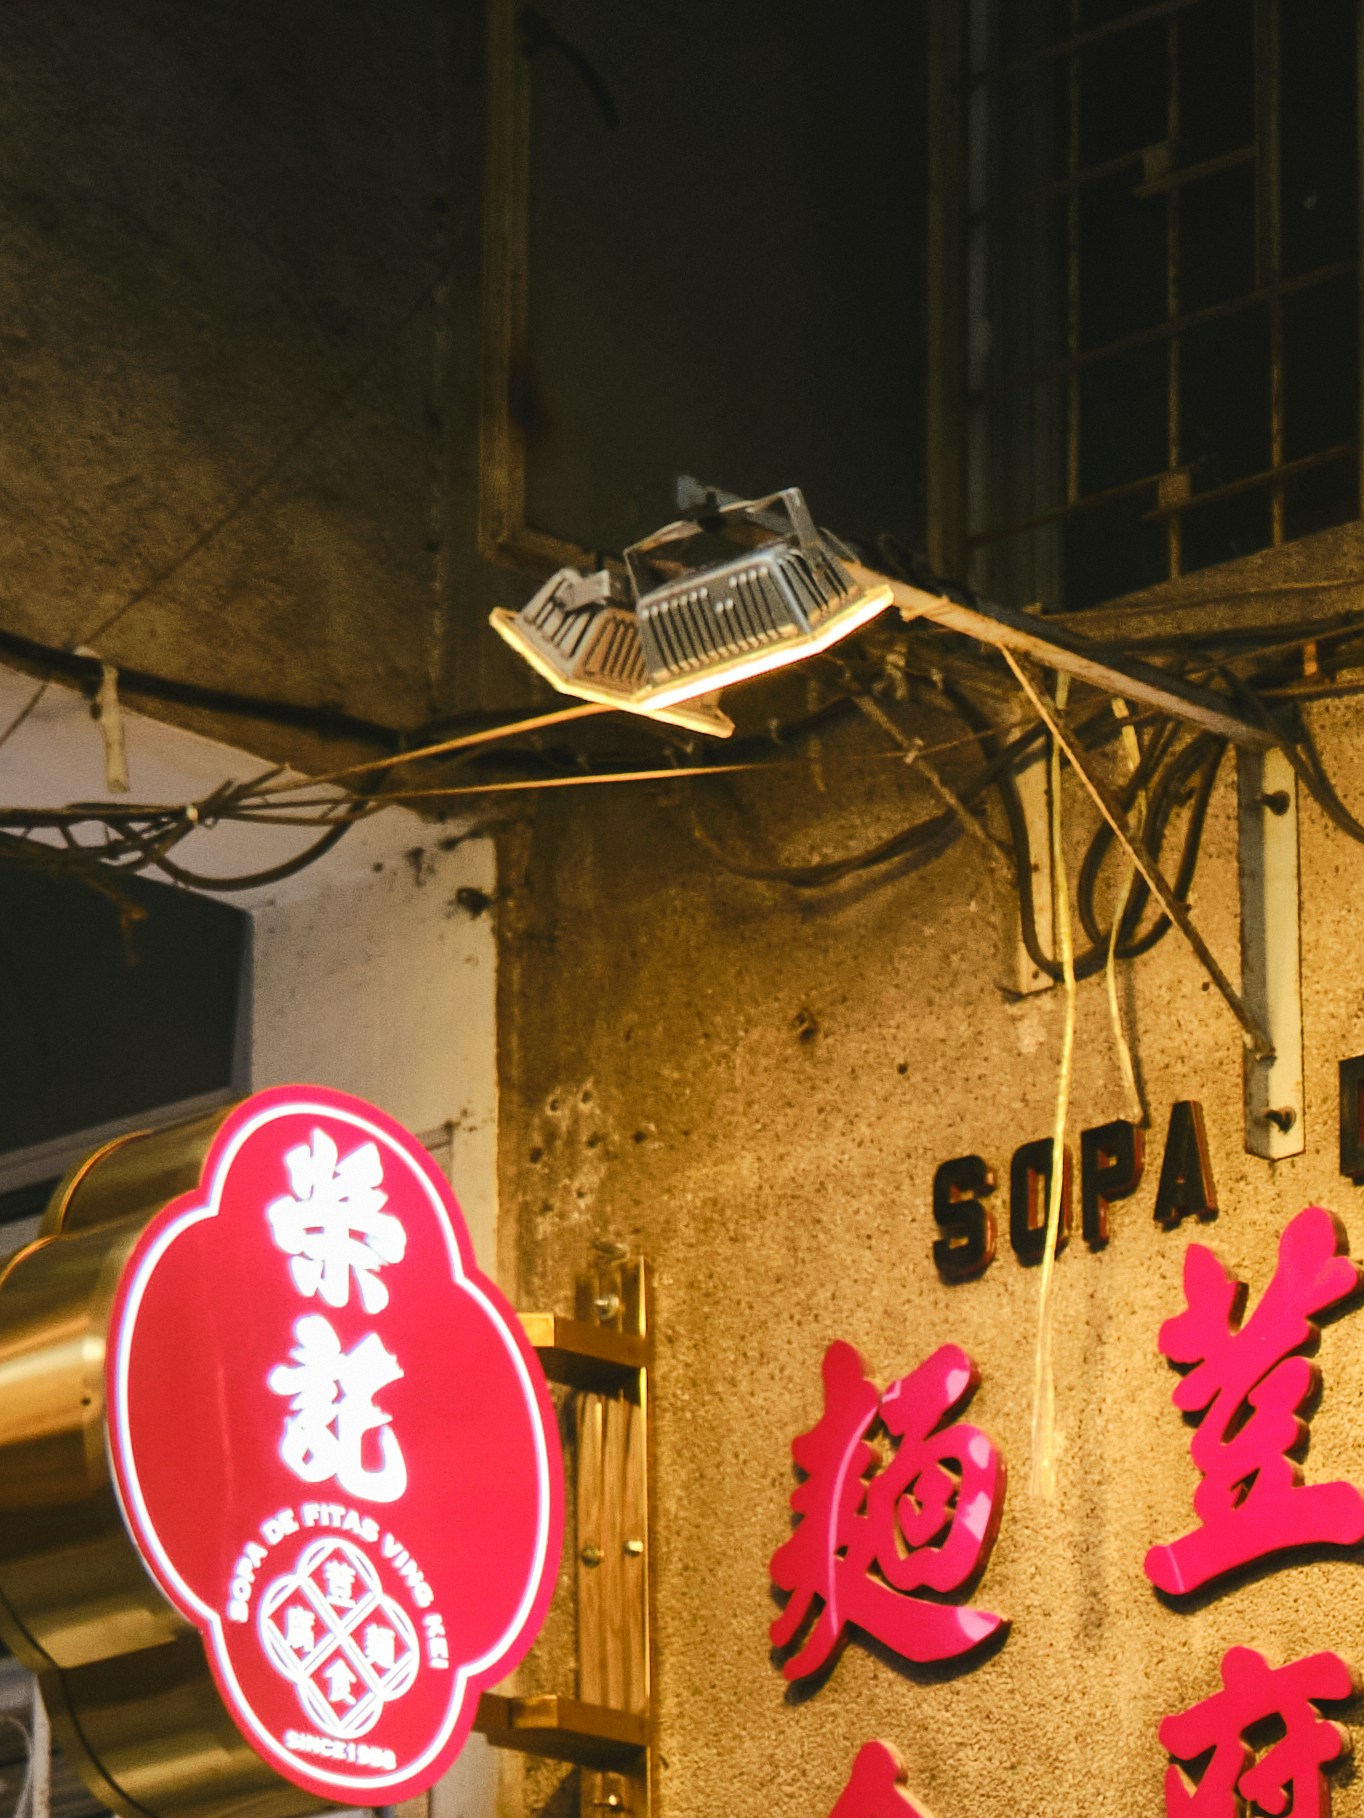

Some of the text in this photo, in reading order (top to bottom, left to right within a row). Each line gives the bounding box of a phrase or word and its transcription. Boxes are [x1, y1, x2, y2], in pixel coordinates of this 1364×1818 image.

[932, 1098, 1220, 1286] SOPA
[227, 1503, 449, 1669] SOPA DE FITAS VING KEI
